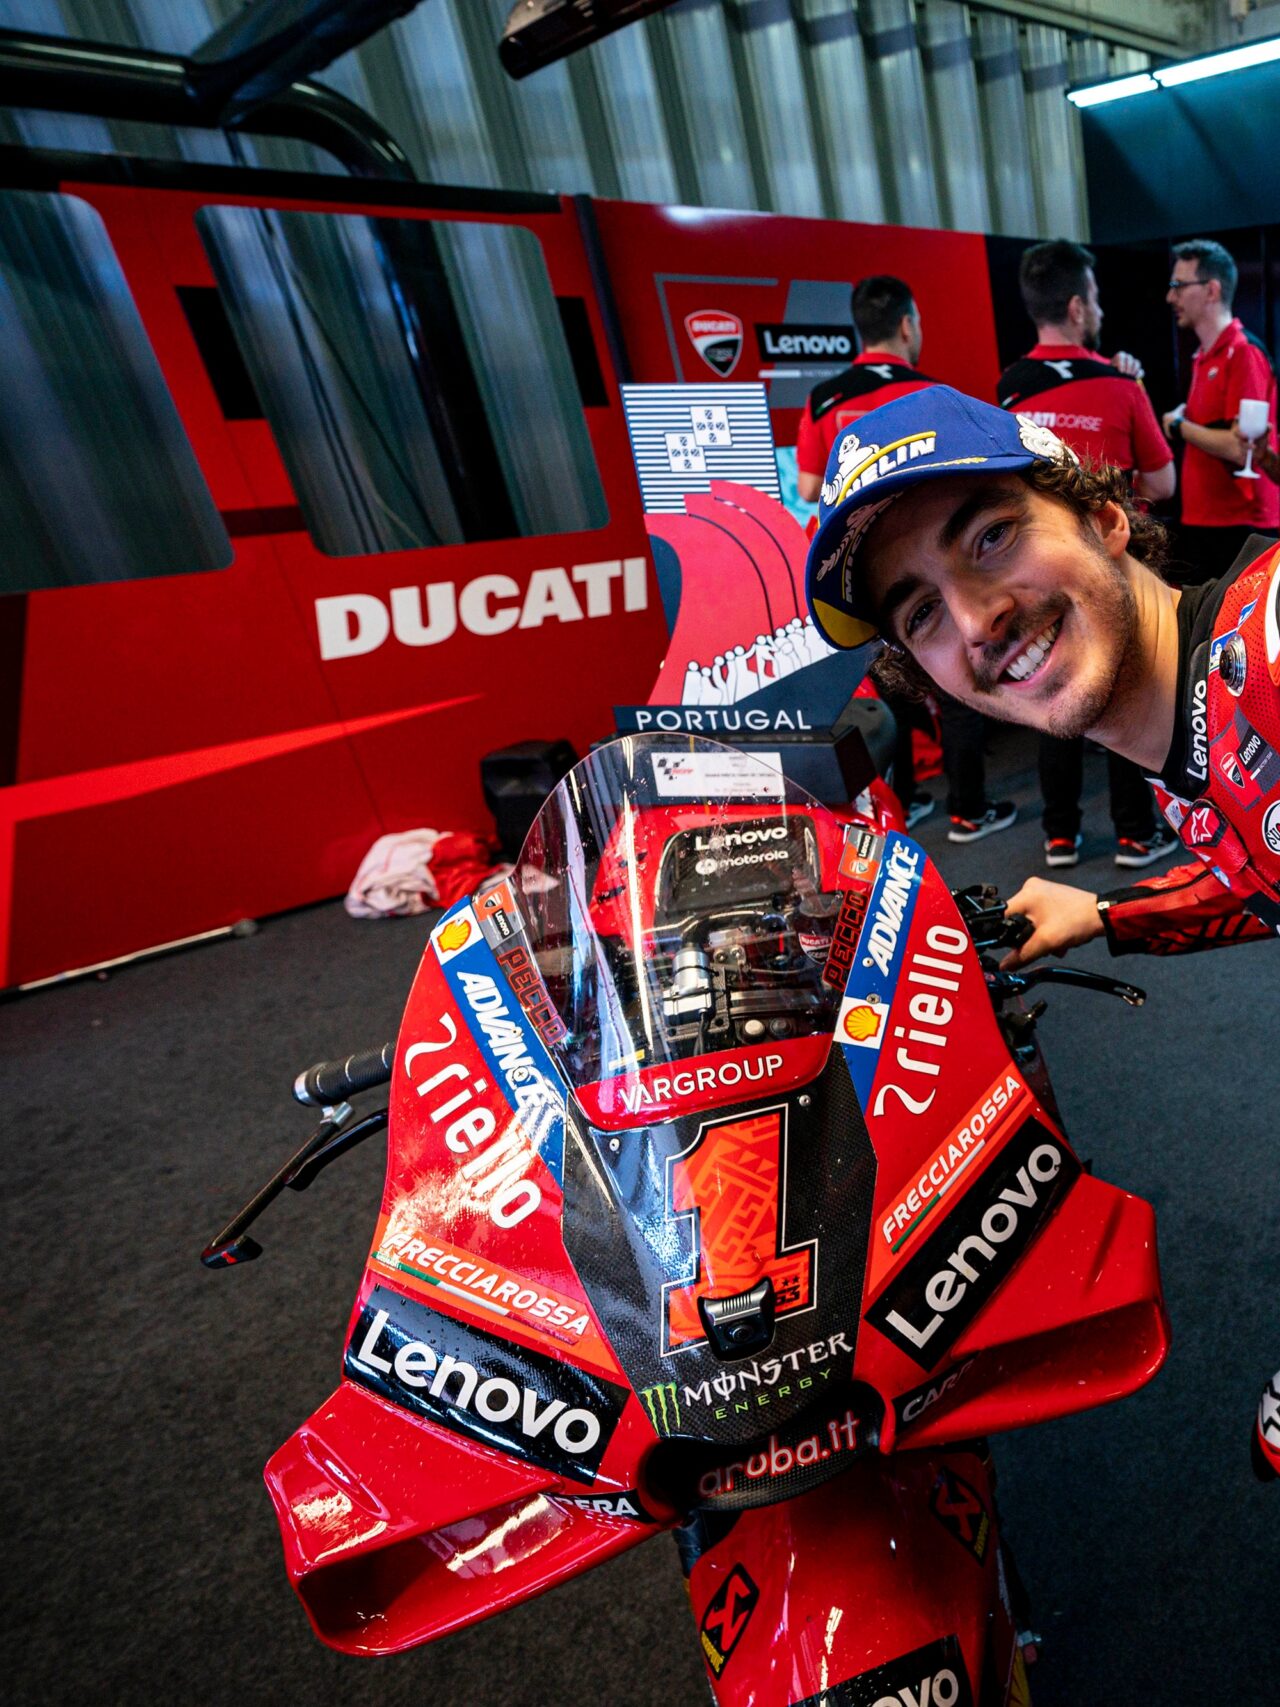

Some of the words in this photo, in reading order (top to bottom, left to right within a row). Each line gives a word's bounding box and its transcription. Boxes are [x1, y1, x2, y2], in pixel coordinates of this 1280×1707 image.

[764, 330, 851, 355] Lenovo
[315, 557, 648, 661] DUCATI
[635, 710, 812, 732] PORTUGAL
[1187, 679, 1207, 781] Lenovo
[1239, 735, 1261, 765] Lenovo
[860, 834, 872, 858] Lenovo
[494, 909, 511, 938] Lenovo
[822, 889, 869, 992] PECCO
[867, 840, 920, 977] ADVANCE
[496, 945, 568, 1046] PECCO
[894, 924, 969, 1076] riello
[619, 1053, 784, 1115] VARGROUP
[417, 1066, 542, 1230] riello
[882, 1075, 1020, 1244] FRECCIAROSSA
[661, 1102, 818, 1358] 1
[885, 1143, 1062, 1350] Lenovo
[380, 1234, 590, 1337] FRECCIAROSSA
[357, 1310, 600, 1454] Lenovo
[682, 1331, 853, 1406] MONSTER
[715, 1368, 831, 1420] ENERGY
[700, 1411, 860, 1497] aruba.it
